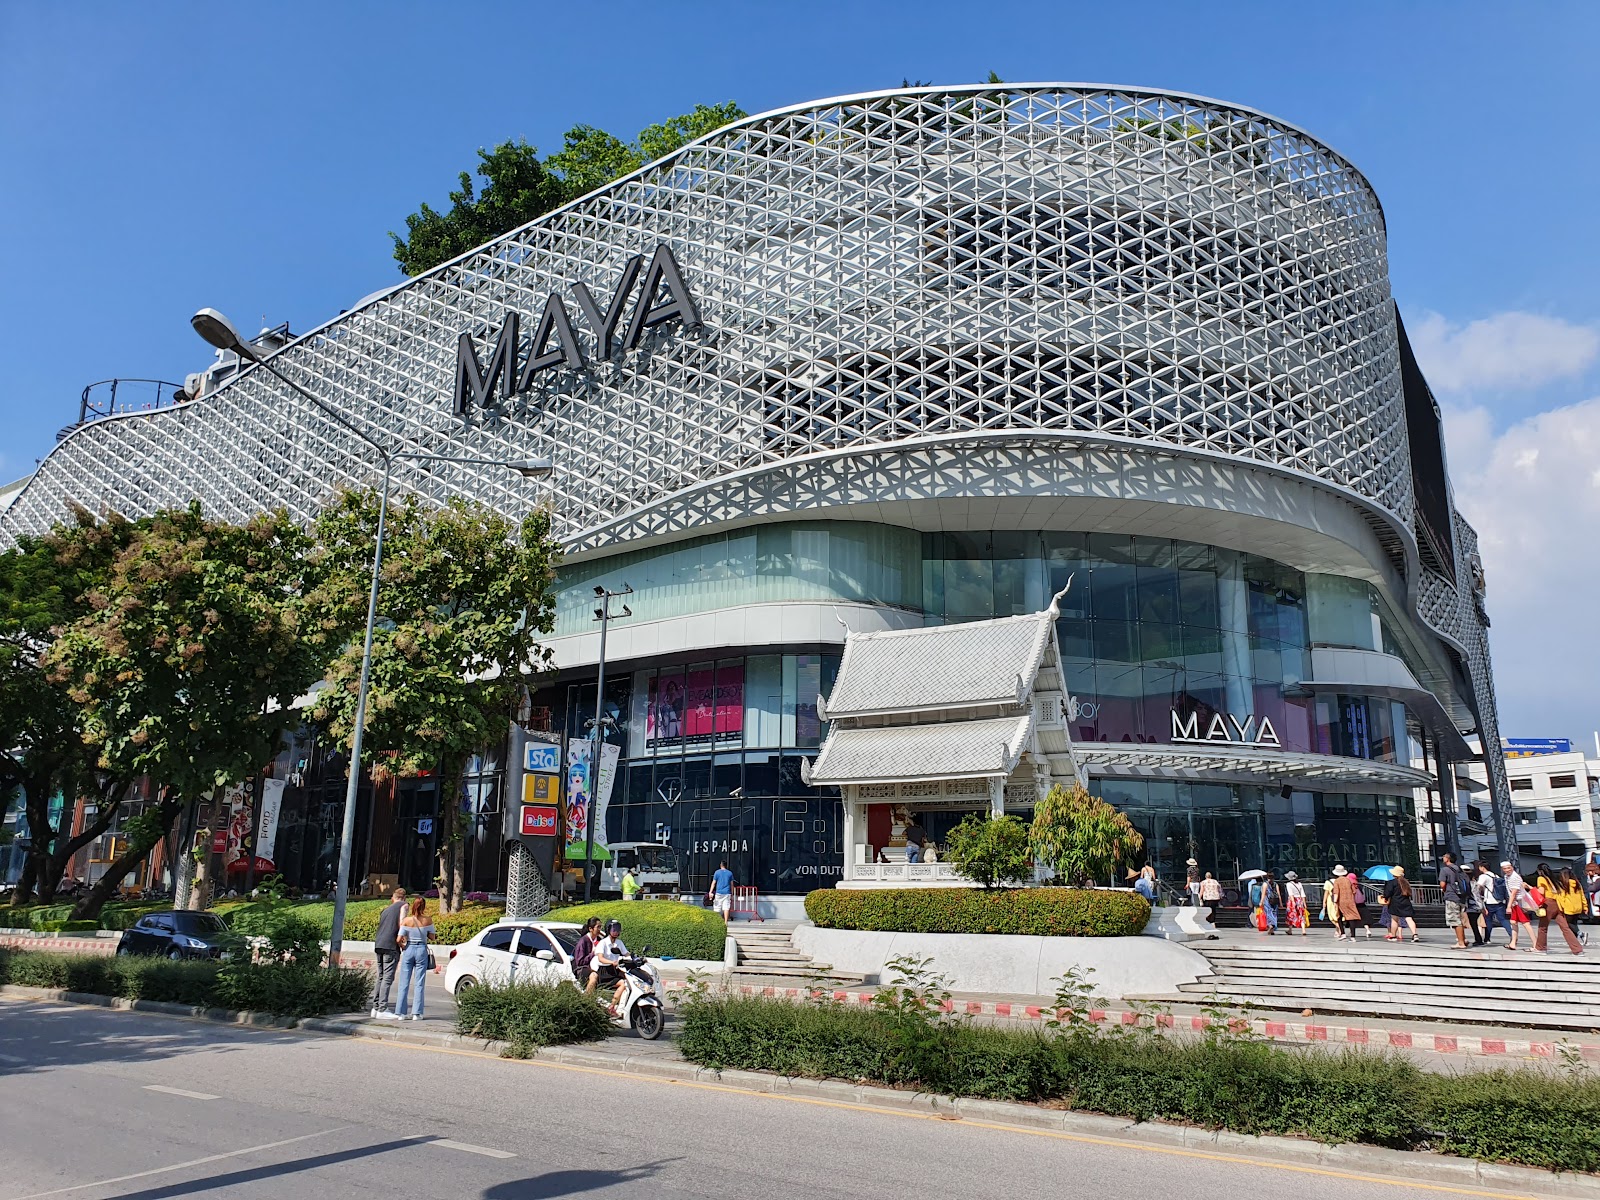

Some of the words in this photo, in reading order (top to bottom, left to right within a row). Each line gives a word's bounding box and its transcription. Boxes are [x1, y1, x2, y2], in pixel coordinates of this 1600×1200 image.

[454, 243, 703, 415] MAYA
[1171, 709, 1281, 745] MAYA
[604, 763, 615, 789] STREET
[261, 810, 271, 839] FOOD
[526, 813, 555, 827] Daiso
[795, 865, 817, 875] VON
